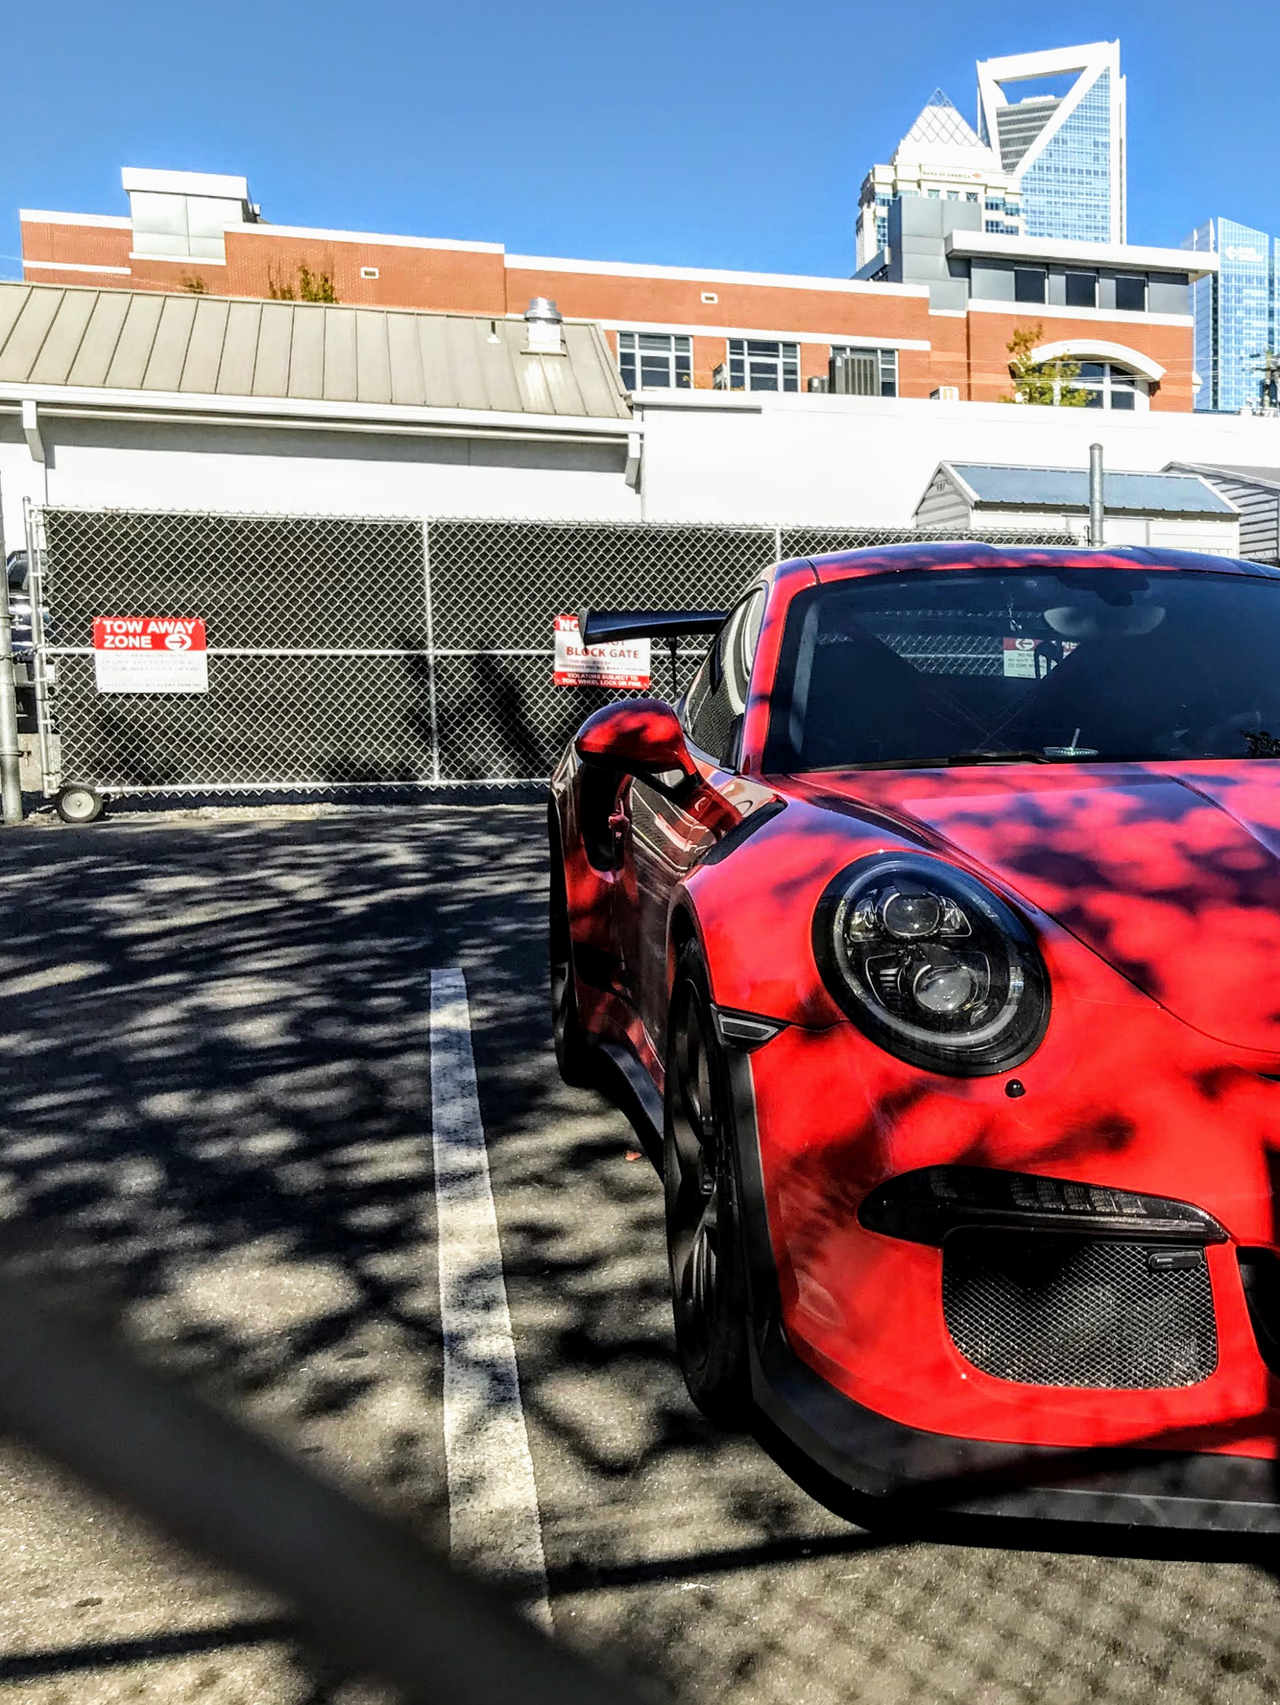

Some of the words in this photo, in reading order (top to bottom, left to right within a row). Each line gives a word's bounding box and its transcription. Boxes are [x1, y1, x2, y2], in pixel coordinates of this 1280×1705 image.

[102, 620, 143, 634] TOW
[147, 620, 196, 635] AWAY
[103, 635, 153, 648] ZONE
[566, 646, 606, 658] BLOCK
[609, 648, 640, 659] GATE
